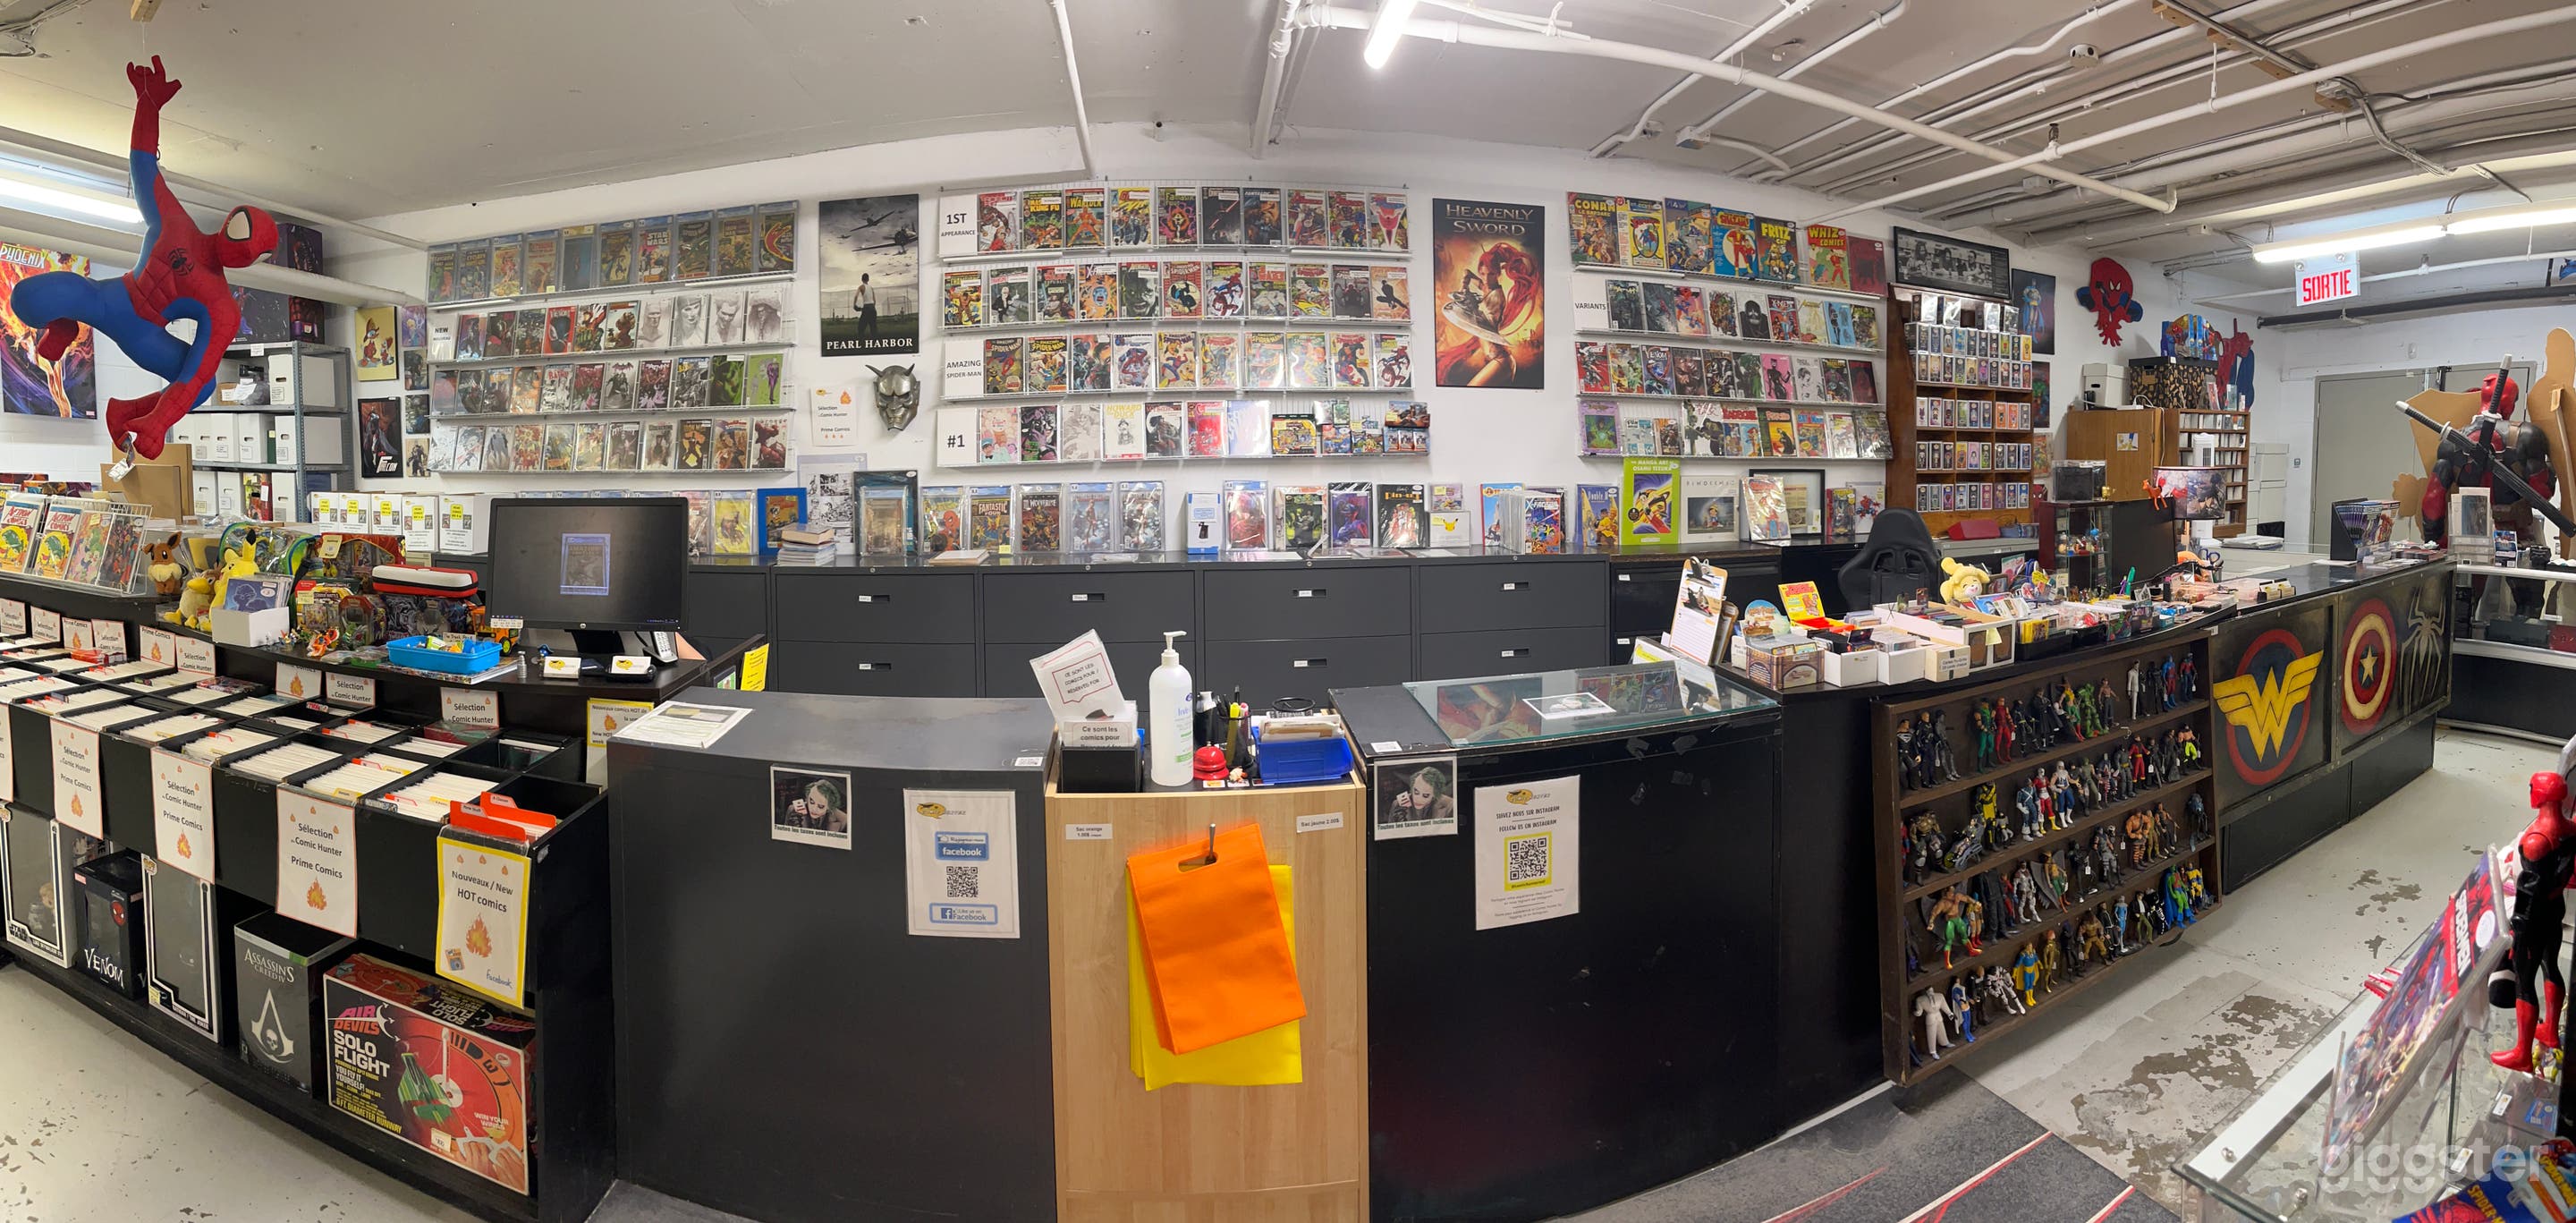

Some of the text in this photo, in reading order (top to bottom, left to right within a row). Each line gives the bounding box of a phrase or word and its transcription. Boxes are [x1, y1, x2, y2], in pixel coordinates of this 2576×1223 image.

[946, 213, 967, 225] 1ST
[1445, 204, 1533, 221] HEAVENLY
[647, 231, 668, 239] STAR
[940, 229, 976, 237] APPEARANCE
[1453, 221, 1525, 236] SWORD
[1760, 223, 1791, 241] FRITZ
[1809, 226, 1839, 239] WHIZ
[0, 244, 47, 269] PHOENIX
[2301, 268, 2351, 302] SORTIE
[1574, 302, 1606, 310] VARIANTS
[826, 337, 913, 350] PEARL HARBOR
[946, 359, 981, 369] AMAZING
[946, 371, 982, 379] SPIDER-MAN
[947, 434, 966, 448] #1
[979, 500, 1008, 514] FANTASTIC
[184, 651, 207, 662] Sélection
[182, 661, 213, 673] Comic Hunter
[336, 679, 365, 692] Sélection
[334, 692, 372, 704] Comic Hunter
[453, 701, 487, 713] Sélection
[451, 715, 495, 726] Comic Hunter
[64, 746, 86, 760] Sélection
[62, 757, 91, 774] Comic Hunter
[60, 773, 92, 793] Prime Comics
[167, 780, 196, 796] Sélection
[165, 792, 203, 812] Comic Hunter
[163, 809, 204, 832] Prime Comics
[298, 822, 334, 841] Sélection
[295, 837, 343, 857] Comic Hunter
[942, 846, 982, 856] facebook
[291, 855, 343, 879] Prime Comics
[451, 870, 489, 889] Nouveaux
[496, 882, 514, 896] New
[457, 888, 508, 913] HOT comics
[953, 913, 987, 921] Facebook
[84, 948, 124, 989] VENOM
[244, 948, 294, 982] ASSASSIN'S
[254, 964, 278, 980] CREED
[339, 1005, 376, 1018] AIR
[334, 1019, 380, 1035] DEVILS
[334, 1030, 377, 1057] SOLO
[335, 1043, 390, 1078] FLIGHT
[335, 1065, 361, 1082] YOU FLY IT
[335, 1073, 365, 1091] YOURSELF!
[347, 1102, 376, 1122] DIAMETER
[376, 1116, 402, 1134] RUNWAY
[474, 1112, 490, 1121] WIN
